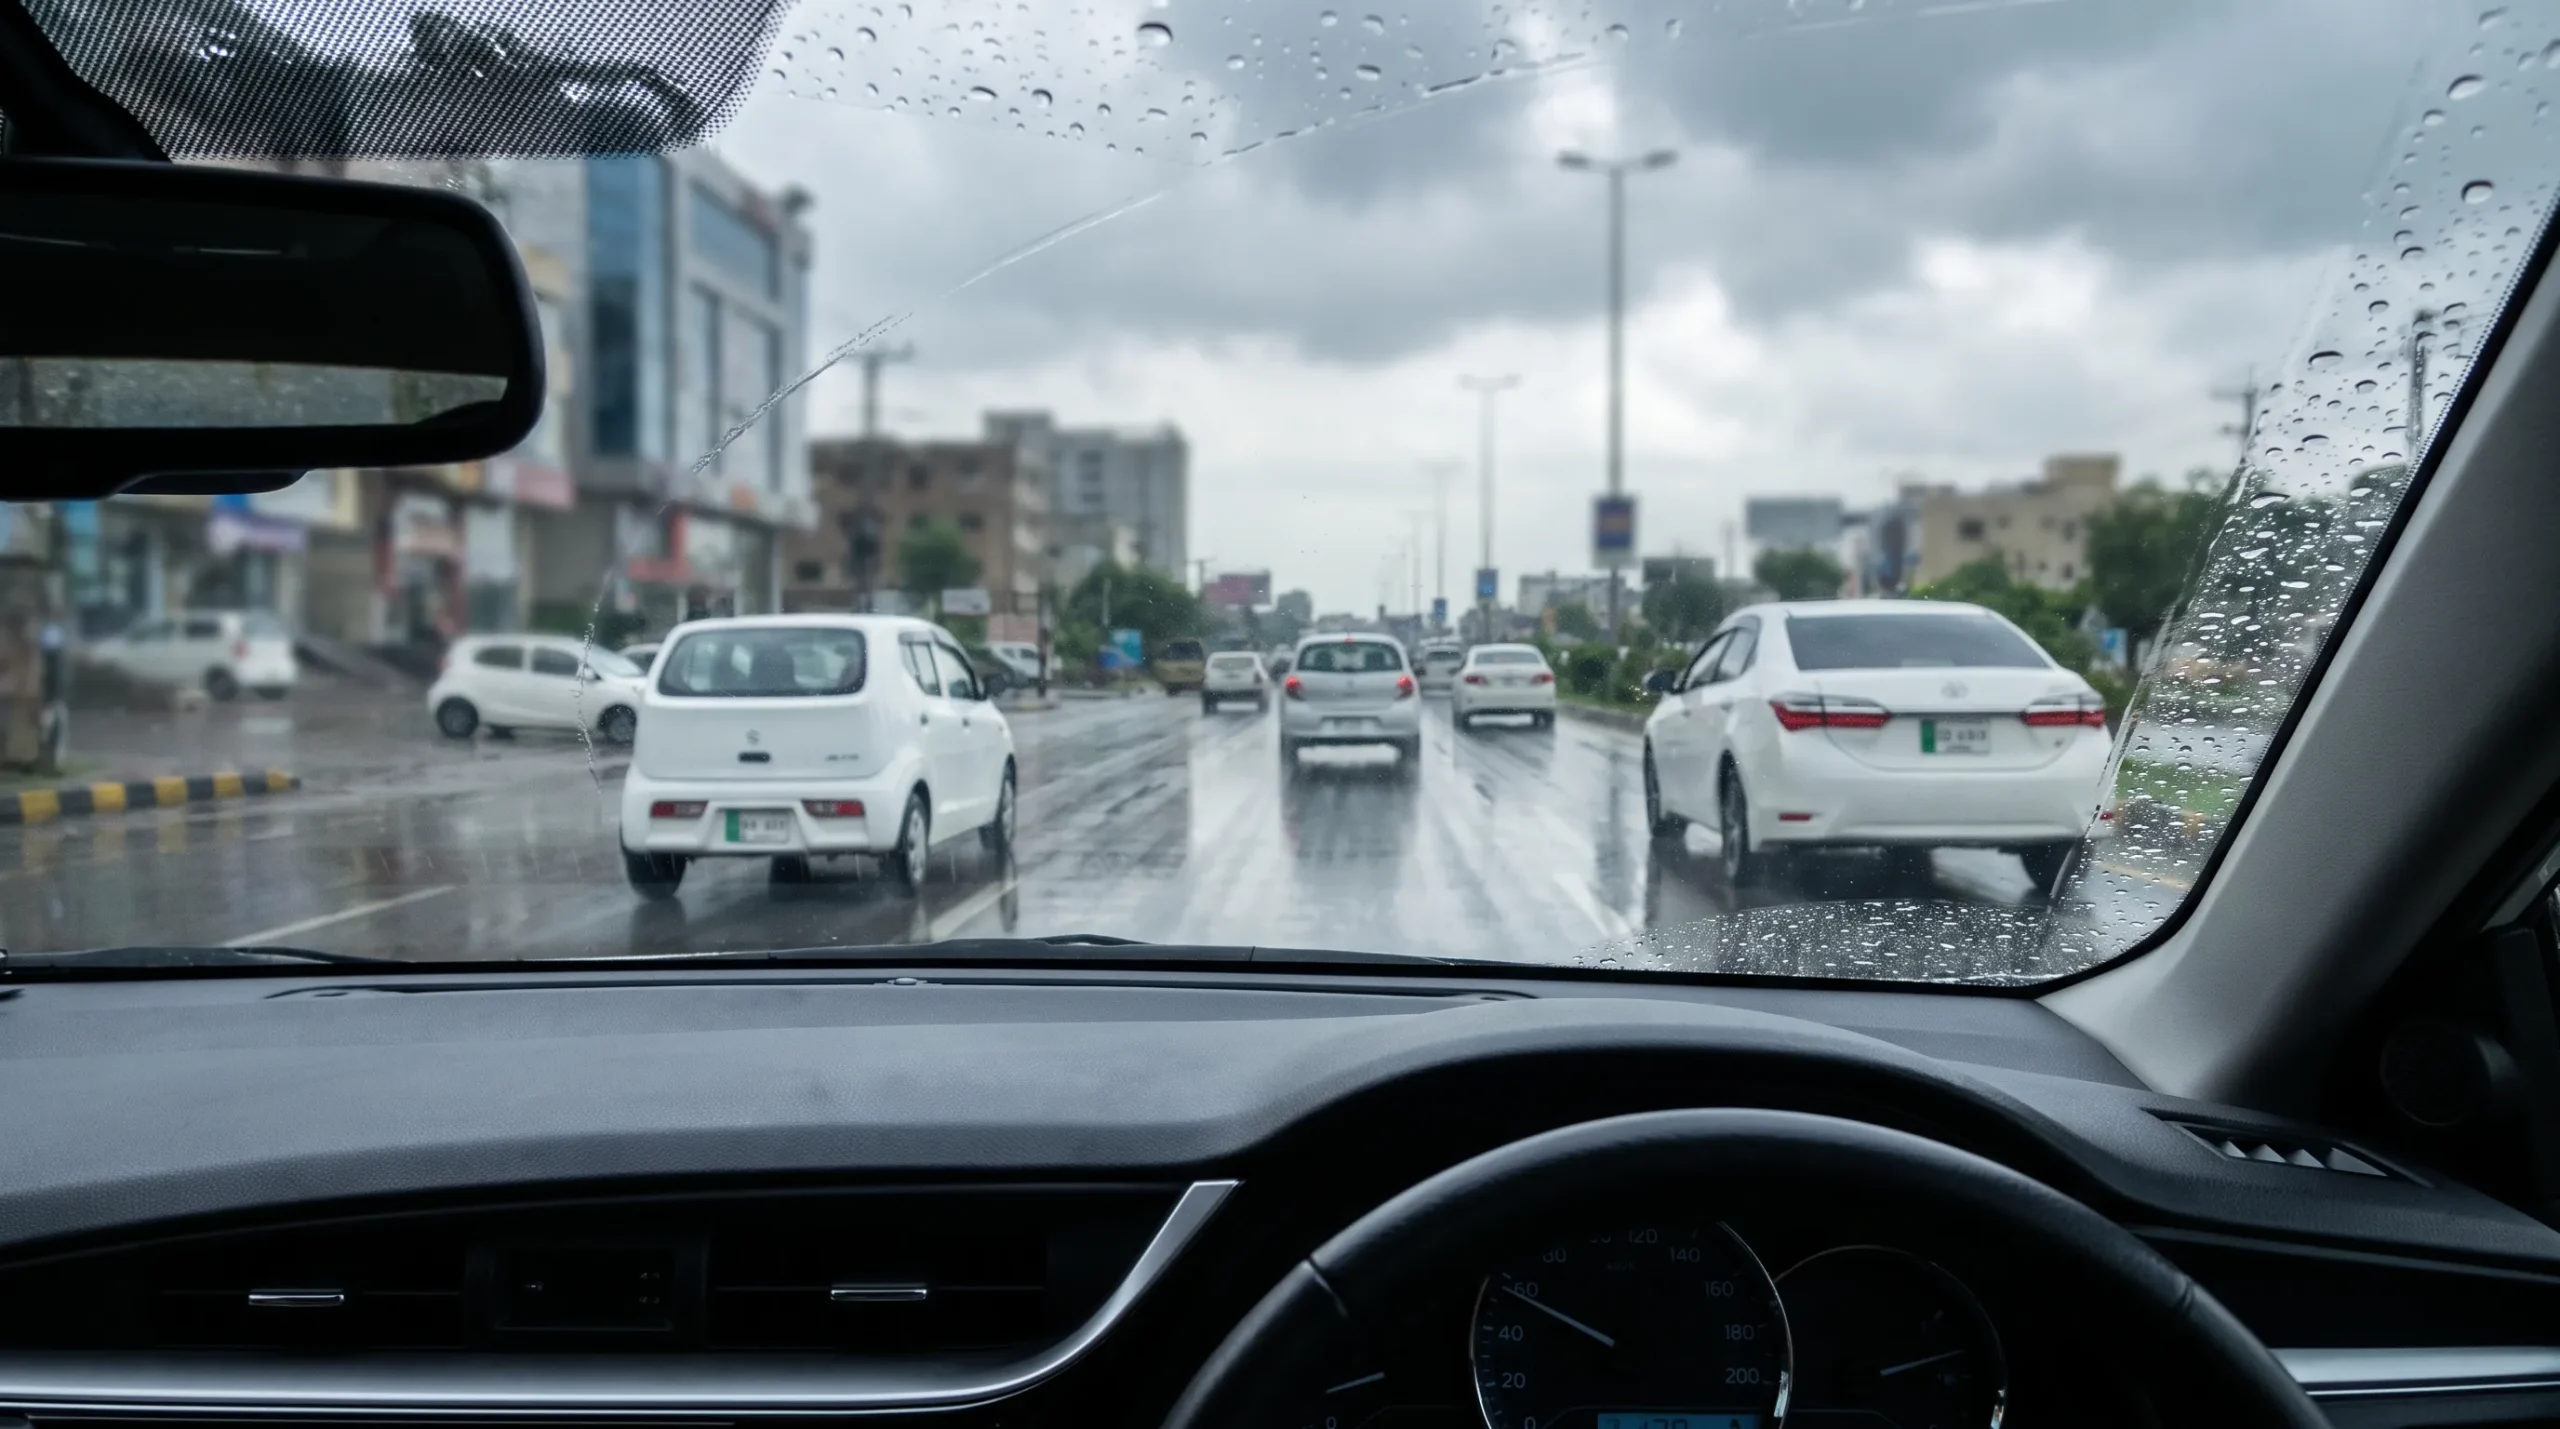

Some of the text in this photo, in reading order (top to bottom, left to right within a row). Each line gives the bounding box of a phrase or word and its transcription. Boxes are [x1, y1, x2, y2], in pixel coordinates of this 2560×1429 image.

[1668, 1246, 1701, 1264] 140
[1513, 1281, 1539, 1298] 60
[1704, 1280, 1734, 1298] 160
[1498, 1324, 1524, 1342] 40
[1724, 1324, 1755, 1341] 180
[1501, 1372, 1526, 1389] 20
[1725, 1367, 1760, 1385] 200
